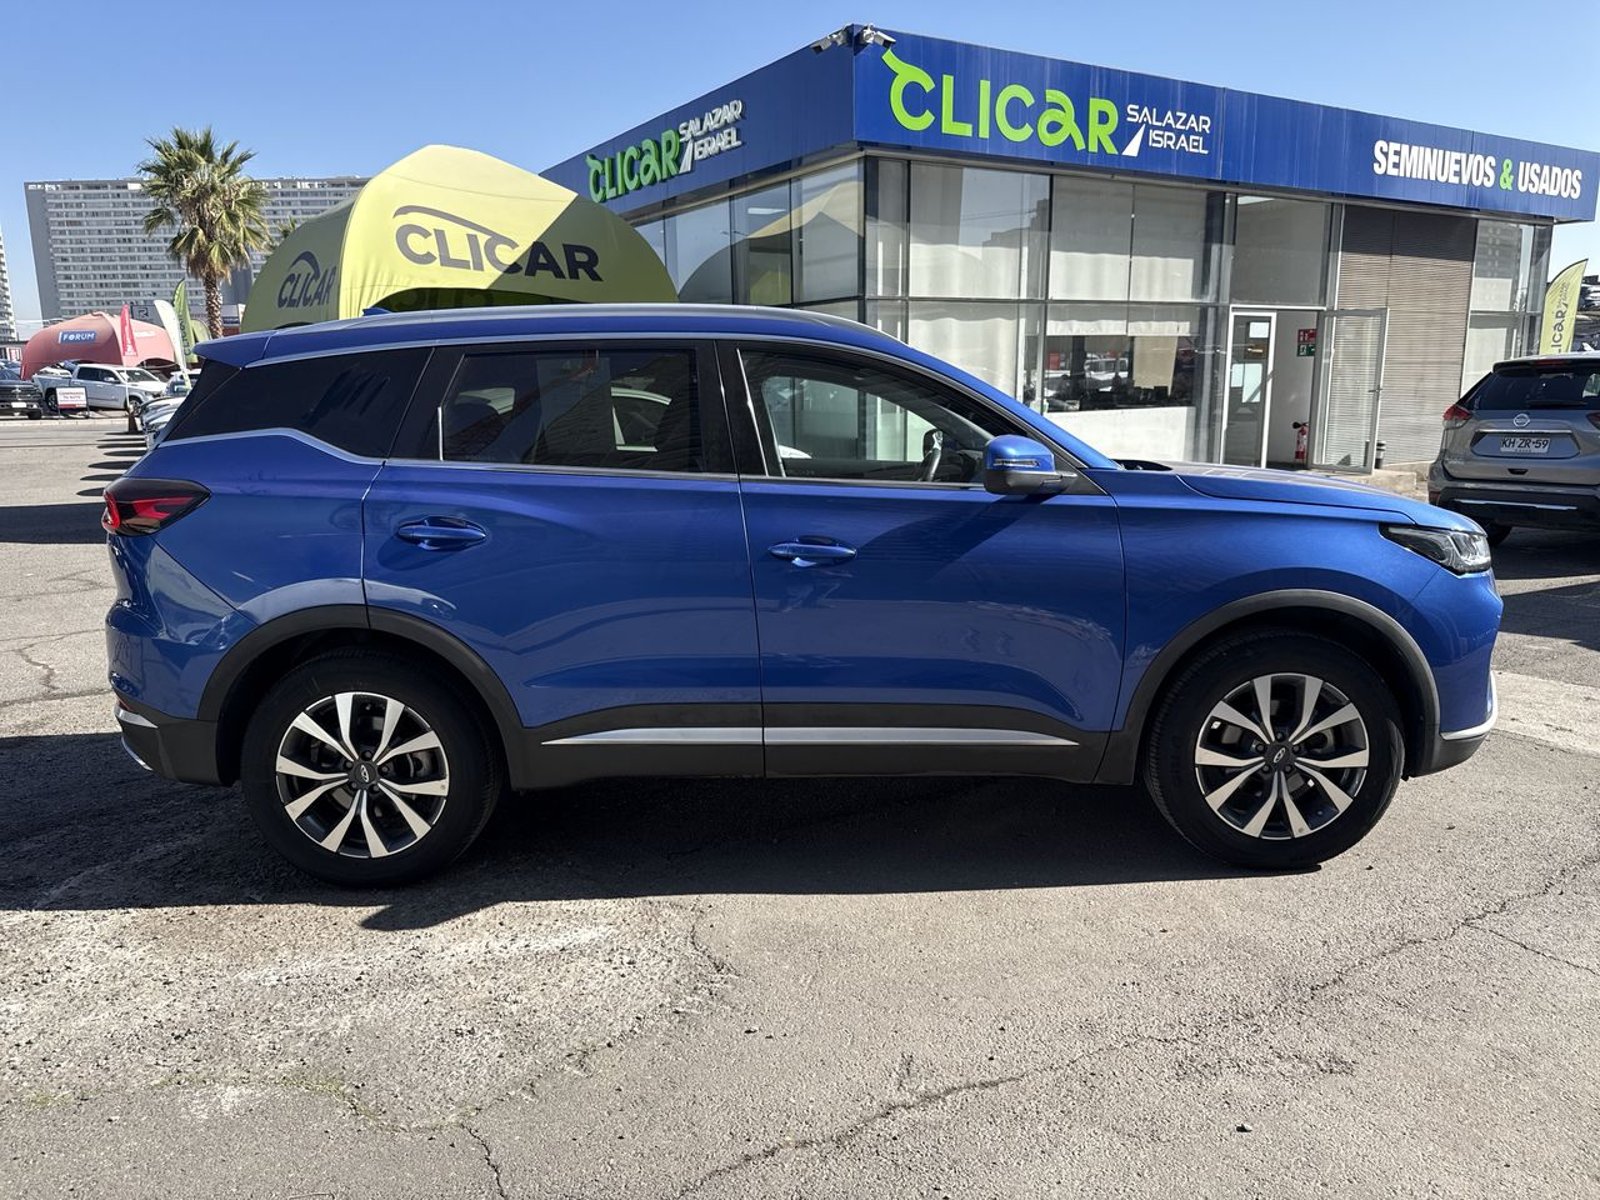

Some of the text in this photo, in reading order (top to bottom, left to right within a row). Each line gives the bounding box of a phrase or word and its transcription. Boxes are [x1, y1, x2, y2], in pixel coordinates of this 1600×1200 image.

[678, 99, 743, 143] SALAZAR
[1126, 103, 1212, 134] SALAZAR
[1149, 128, 1209, 155] ISRAEL
[1373, 139, 1583, 200] SEMINUEVOS & USADOS
[395, 224, 603, 282] CLICAR
[277, 265, 338, 310] CLICAR
[63, 332, 96, 341] FORUM
